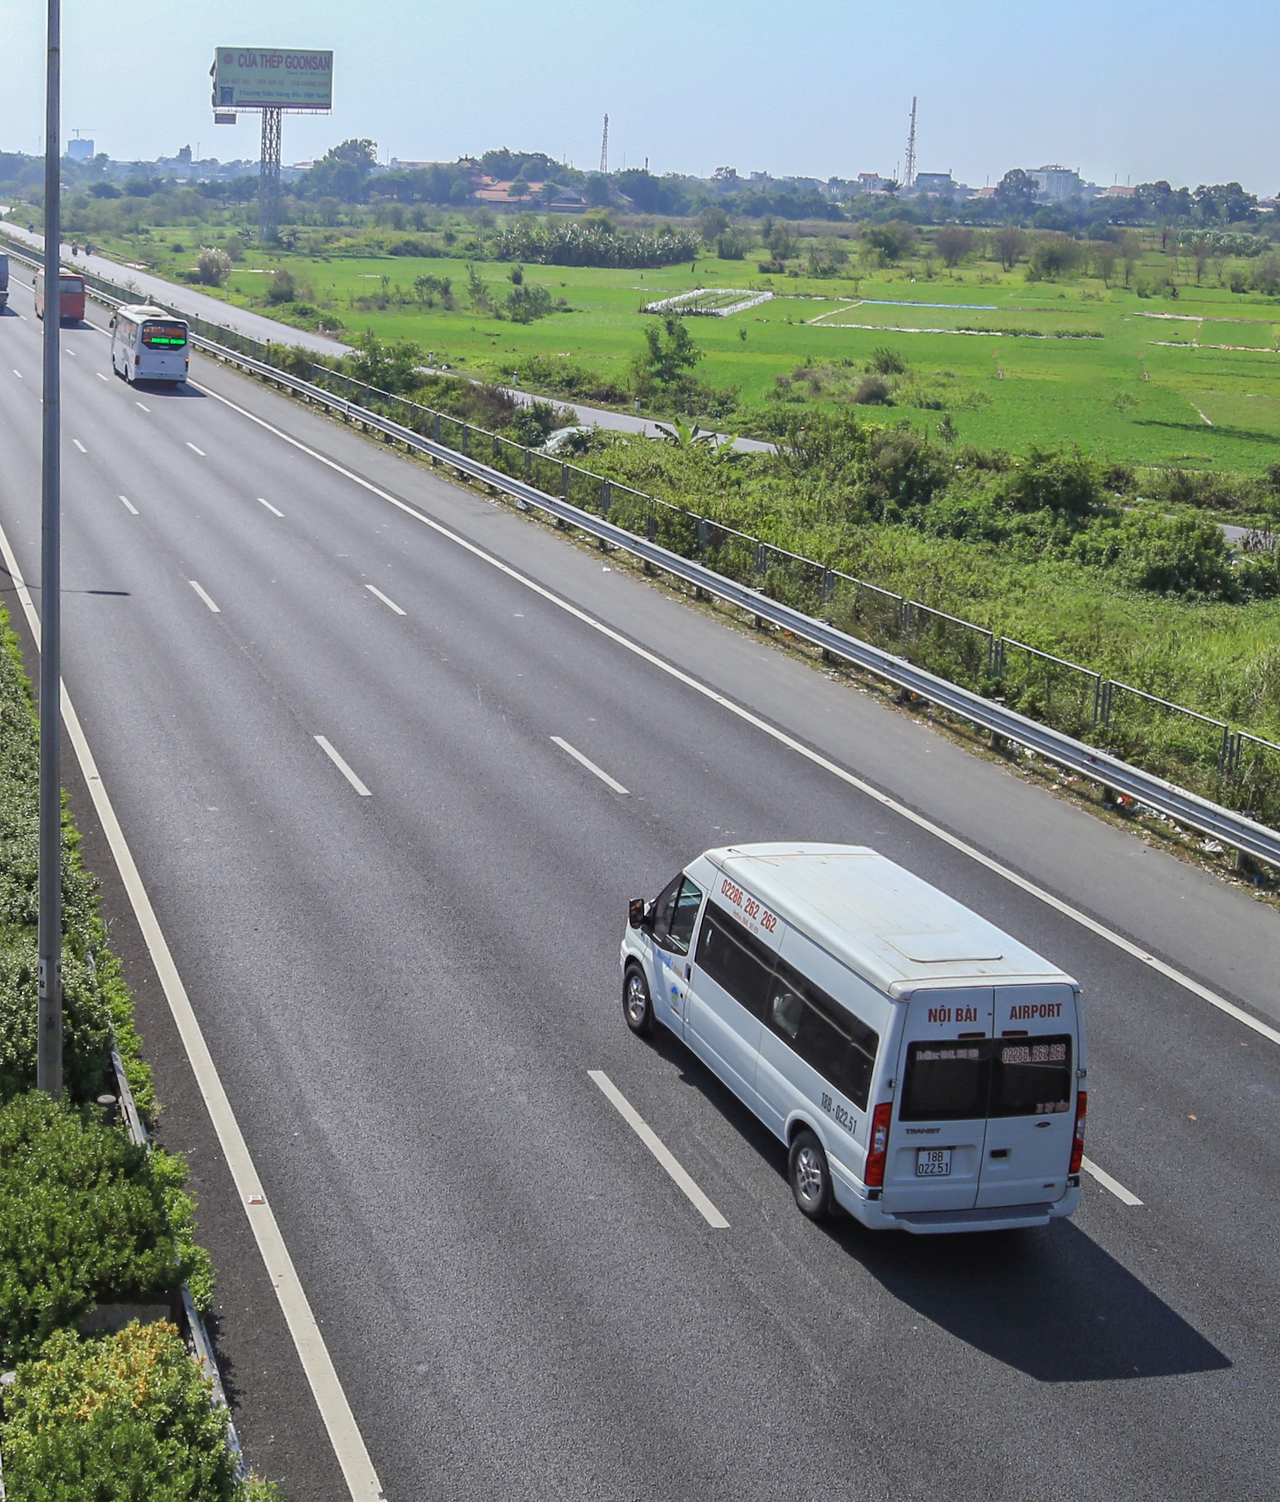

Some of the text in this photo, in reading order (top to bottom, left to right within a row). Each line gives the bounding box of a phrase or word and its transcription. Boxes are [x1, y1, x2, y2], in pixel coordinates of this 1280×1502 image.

[260, 51, 284, 69] THÉP
[285, 55, 331, 71] GOONSAN
[744, 897, 761, 920] 262
[762, 910, 778, 934] 262
[928, 1004, 952, 1027] NỘI
[955, 1004, 978, 1023] BÀI
[1009, 1003, 1063, 1021] AIRPORT
[1032, 1045, 1049, 1062] 262
[1049, 1044, 1066, 1061] 262
[926, 1151, 944, 1163] 18B
